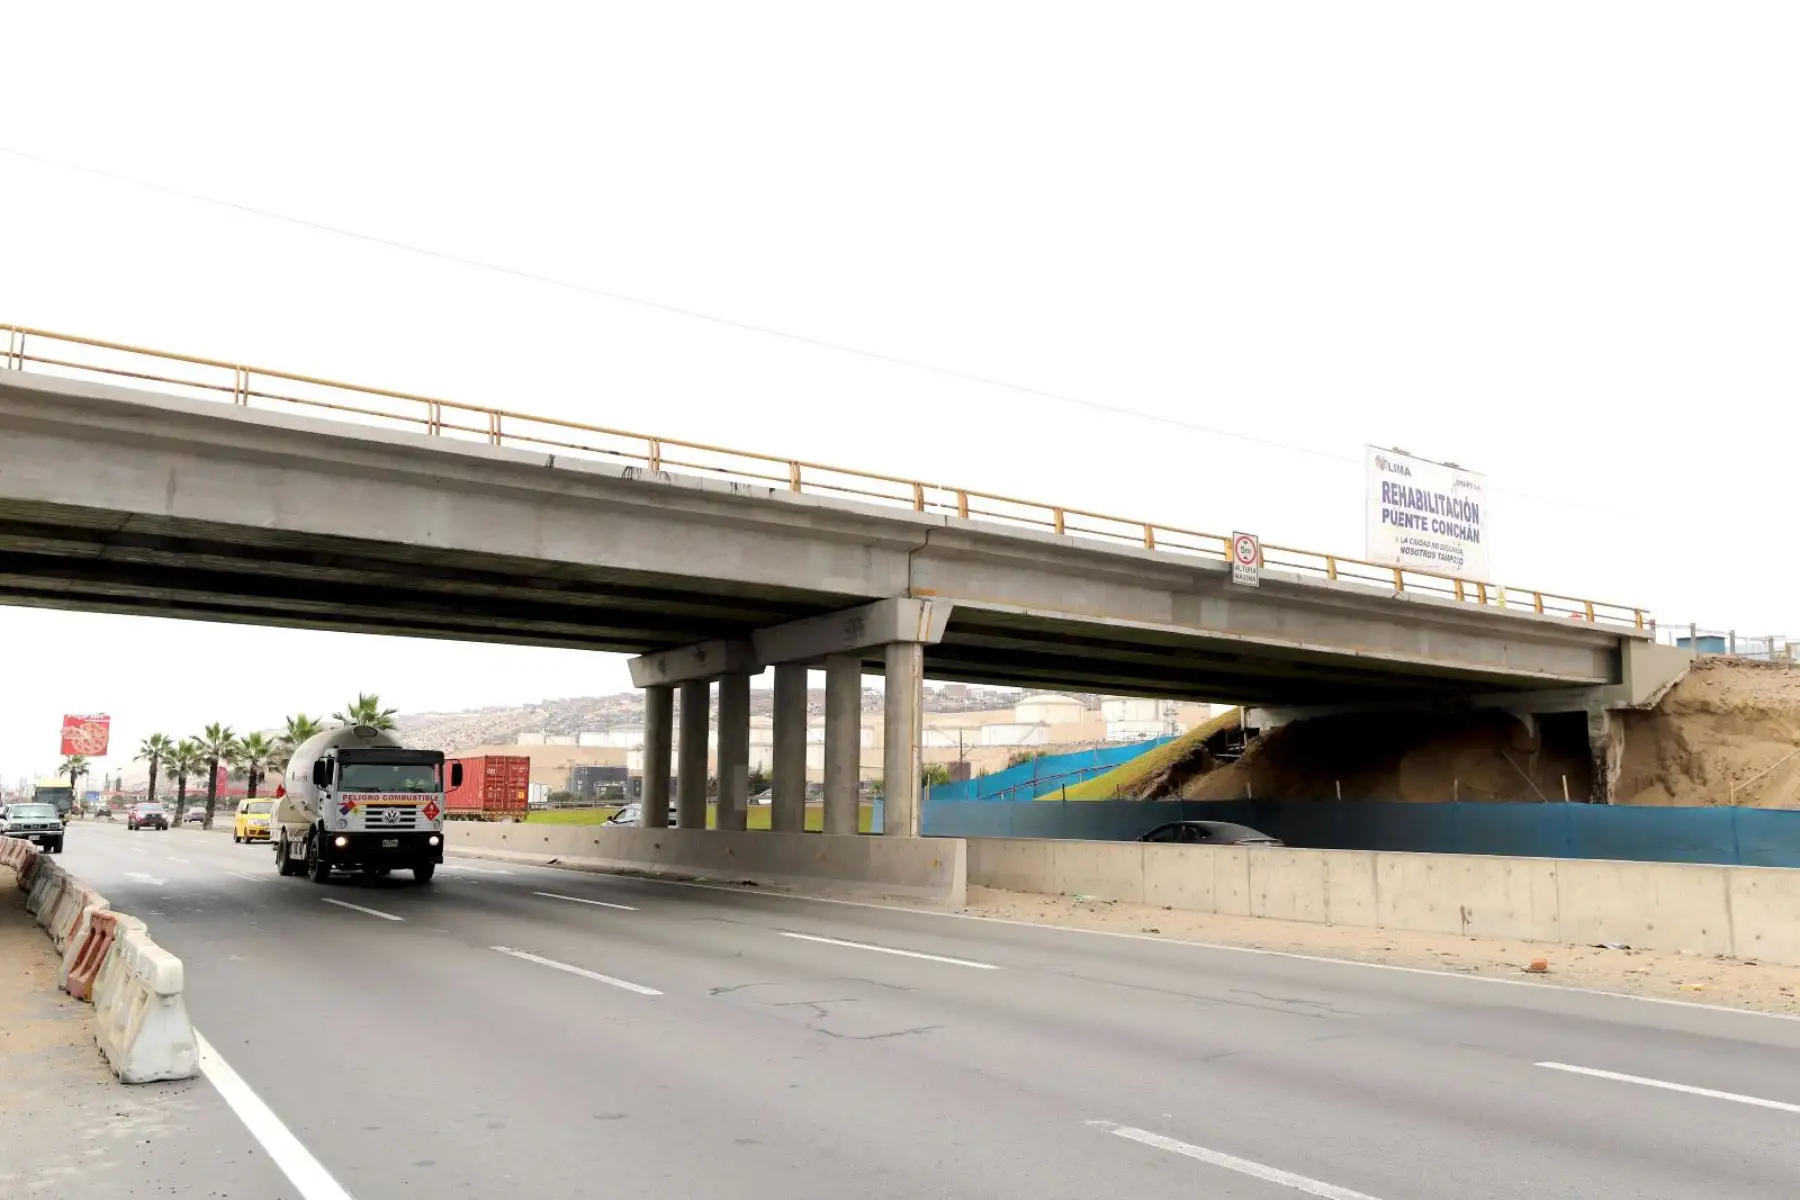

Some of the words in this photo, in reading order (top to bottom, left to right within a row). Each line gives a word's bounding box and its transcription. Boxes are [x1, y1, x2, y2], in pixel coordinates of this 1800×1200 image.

[1388, 462, 1411, 477] LIMA
[1382, 480, 1479, 524] REHABILITACIÓN
[1382, 508, 1428, 532] PUENTE
[1432, 519, 1480, 543] CONCHÁN
[1400, 536, 1408, 544] LA
[1409, 538, 1430, 548] CIUDAD
[1400, 546, 1436, 559] NOSOTROS
